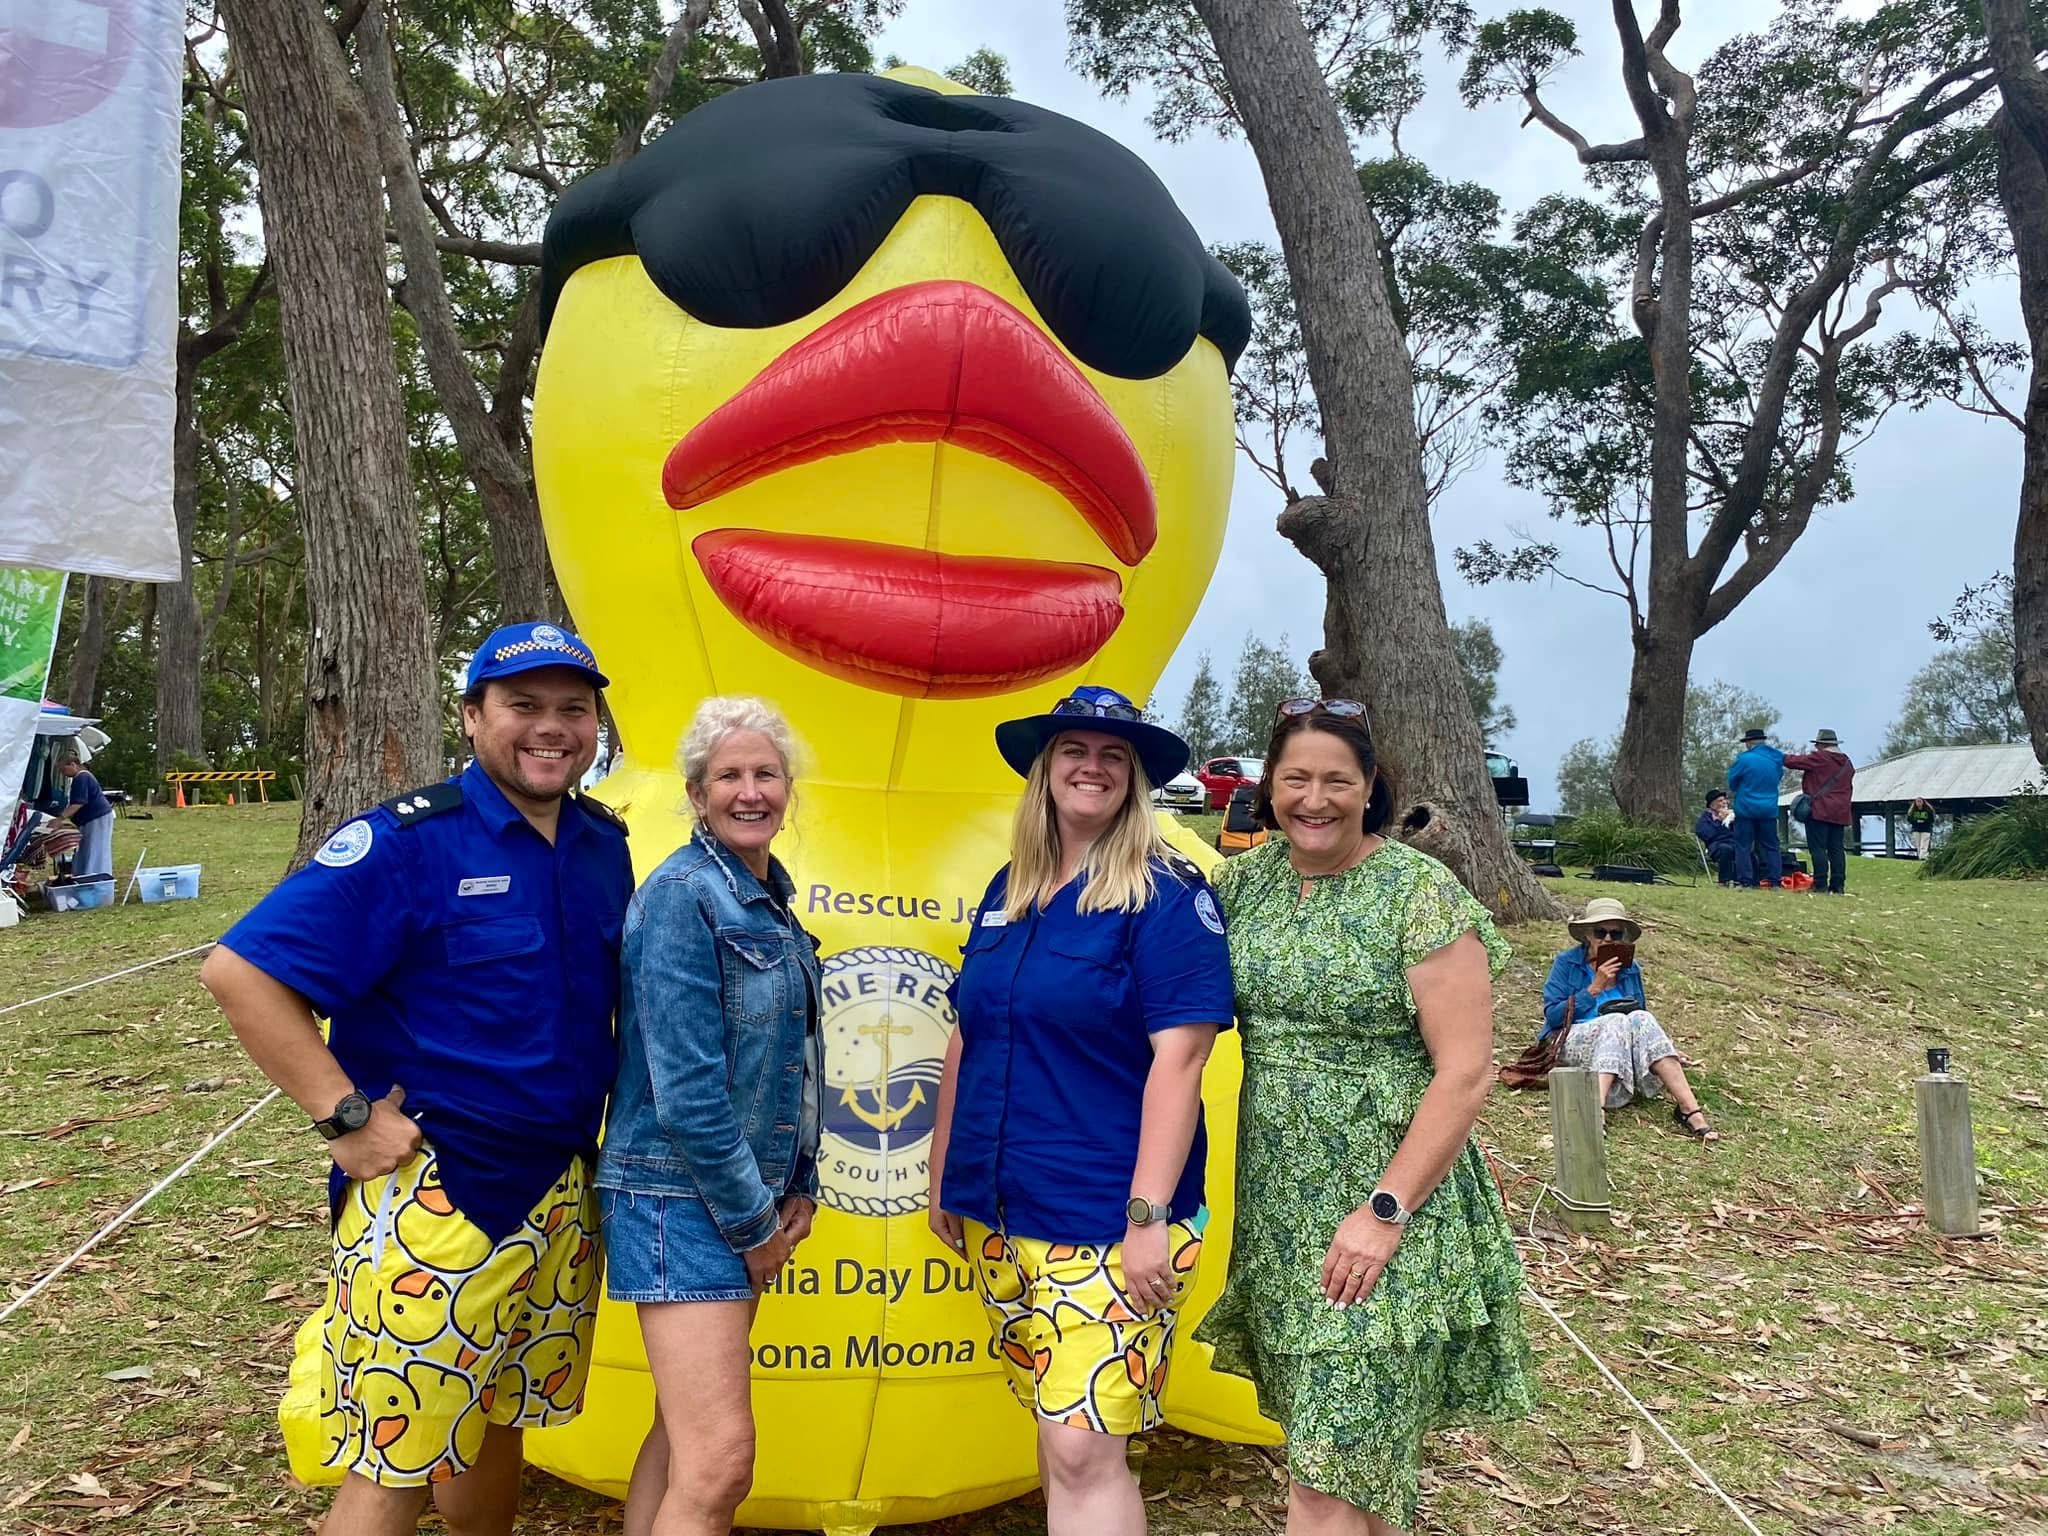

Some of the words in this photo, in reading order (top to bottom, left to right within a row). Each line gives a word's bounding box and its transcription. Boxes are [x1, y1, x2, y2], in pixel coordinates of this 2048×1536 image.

[808, 884, 941, 920] Rescue
[834, 1161, 908, 1183] SOUH
[835, 1258, 912, 1303] Day
[923, 1258, 975, 1294] Du
[750, 1344, 831, 1369] ona
[845, 1335, 975, 1369] Moona
